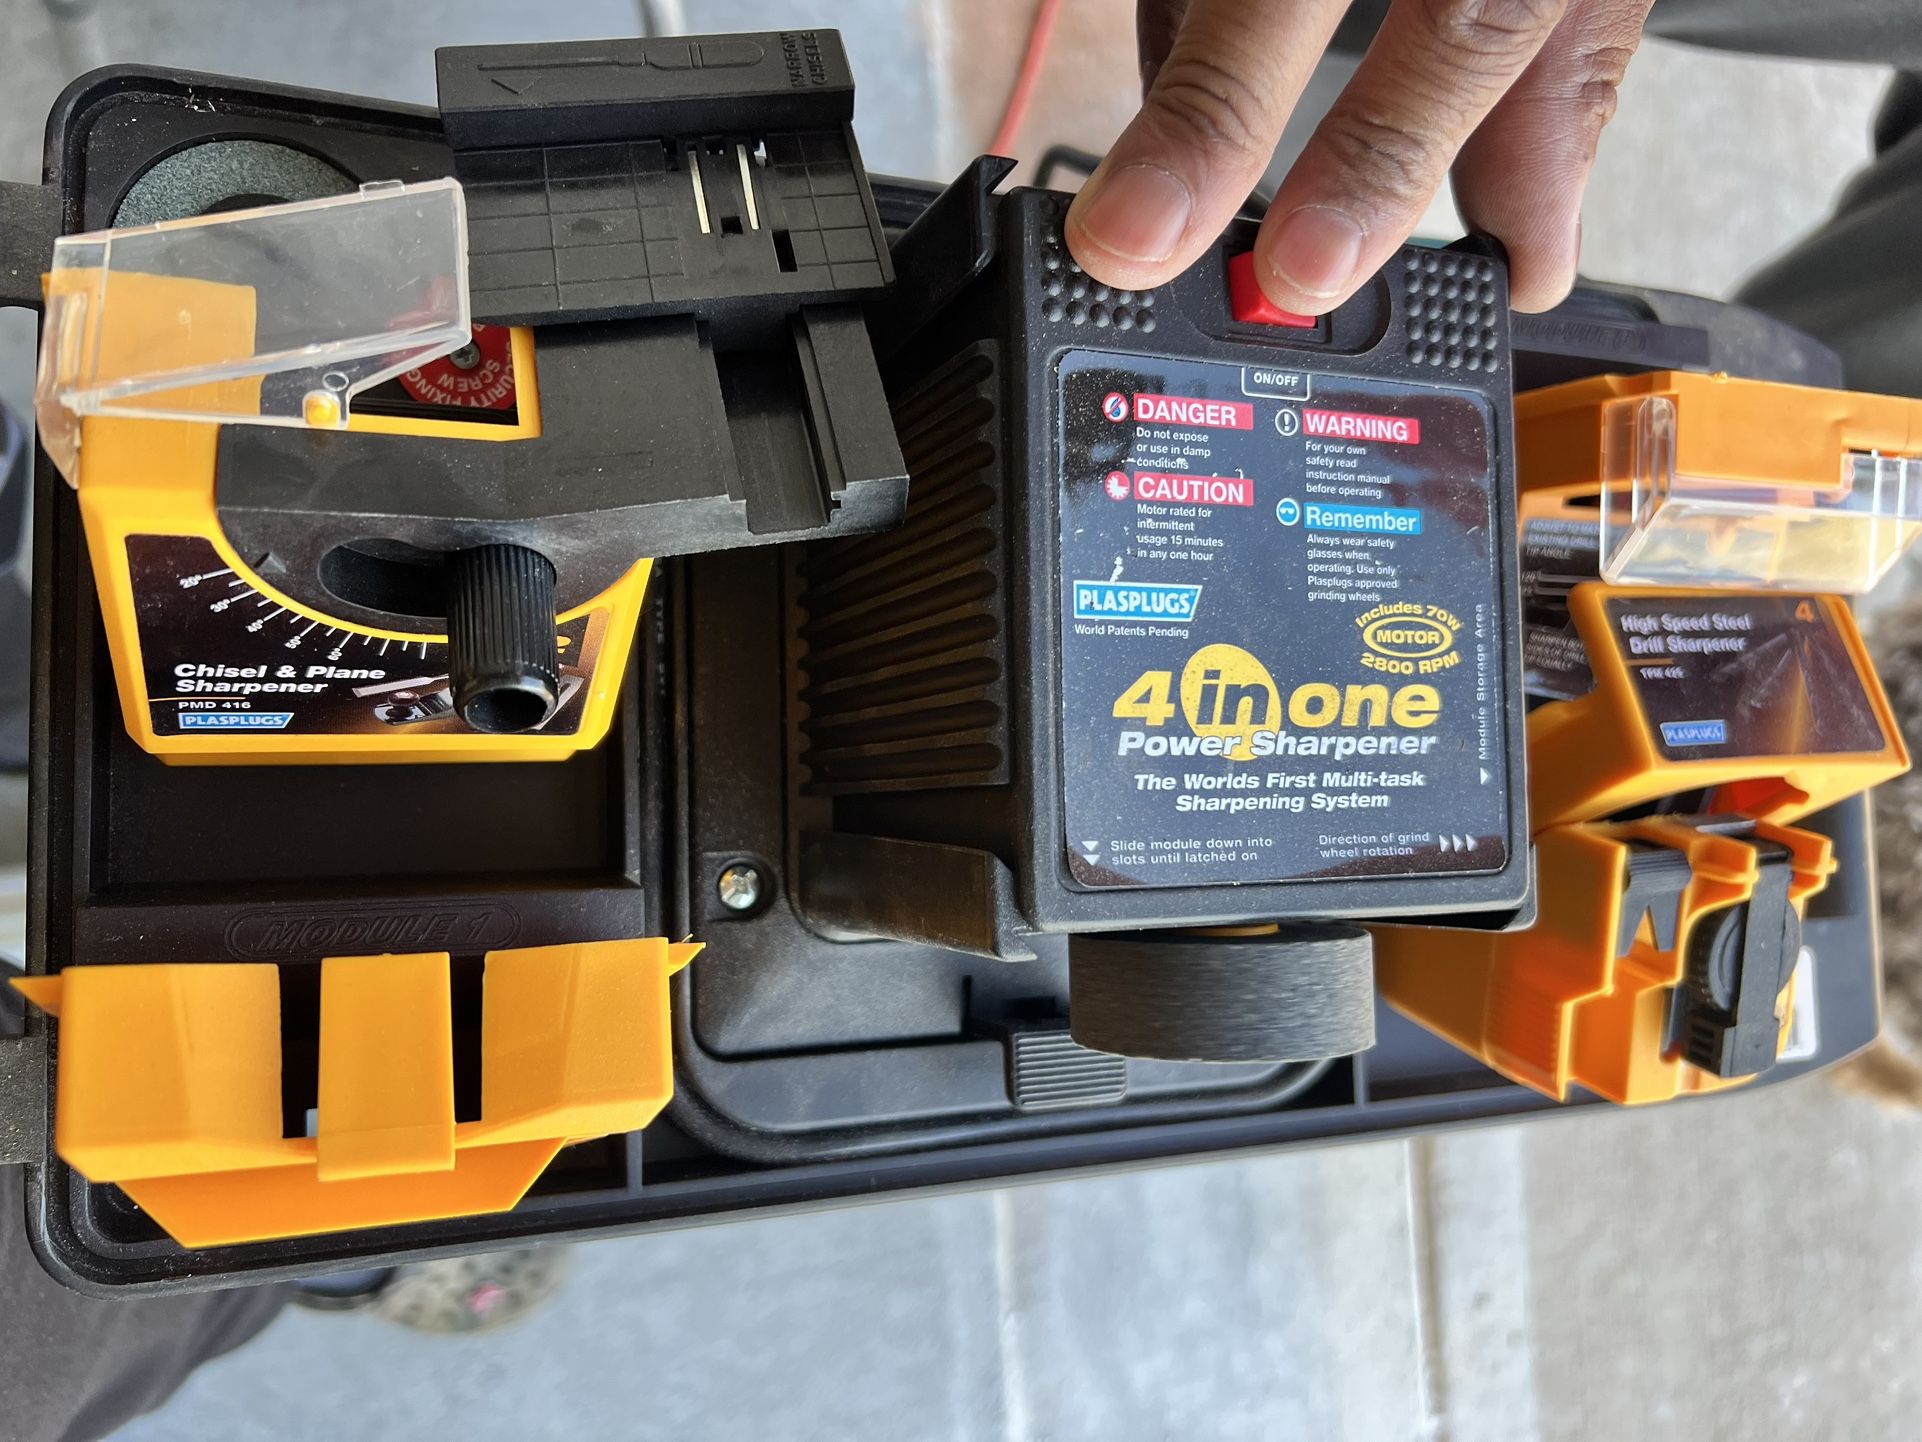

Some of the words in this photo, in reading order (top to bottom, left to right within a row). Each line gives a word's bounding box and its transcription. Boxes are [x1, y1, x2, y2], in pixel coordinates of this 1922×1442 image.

[437, 359, 501, 393] SCREW
[1253, 372, 1299, 387] ON/OFF
[1137, 398, 1237, 427] DANGER
[1305, 412, 1409, 441] WARNING
[1136, 426, 1151, 438] Do
[1153, 429, 1171, 440] not
[1173, 432, 1209, 443] expose
[1136, 443, 1148, 452] or
[1150, 444, 1169, 454] use
[1171, 443, 1181, 455] in
[1182, 445, 1211, 458] damp
[1305, 441, 1321, 451] For
[1324, 444, 1345, 454] your
[1346, 446, 1366, 456] own
[1136, 457, 1190, 470] conditions
[1305, 456, 1334, 468] safety
[1336, 459, 1357, 468] read
[1305, 470, 1355, 482] instruction
[1357, 474, 1391, 484] manual
[1138, 477, 1244, 504] CAUTION
[1306, 483, 1336, 494] before
[1338, 486, 1382, 499] operating
[1137, 503, 1167, 515] Motor
[1169, 507, 1196, 517] rated
[1198, 508, 1213, 518] for
[1137, 519, 1195, 531] intermittent
[1306, 506, 1417, 532] Remember
[1137, 535, 1168, 547] usage
[1171, 534, 1183, 545] 15
[1184, 536, 1224, 547] minutes
[1307, 533, 1340, 547] Always
[1342, 536, 1364, 546] wear
[1367, 537, 1395, 550] safety
[1527, 533, 1568, 546] EXISTING
[1569, 535, 1596, 548] DRILL
[1137, 548, 1147, 558] in
[1149, 550, 1168, 561] any
[1169, 551, 1189, 560] one
[1190, 551, 1214, 561] hour
[1307, 548, 1342, 560] glasses
[1344, 551, 1370, 560] when
[1526, 545, 1540, 557] TIP
[1540, 546, 1572, 559] ANGLE
[1307, 563, 1354, 575] operating.
[1356, 564, 1375, 574] Use
[1376, 566, 1396, 577] only
[179, 574, 203, 589] 20°
[1307, 575, 1353, 589] Plasplugs
[1355, 579, 1398, 590] approved
[1079, 589, 1191, 615] PLASPLUGS
[1307, 590, 1346, 603] grinding
[1348, 591, 1381, 602] wheels
[210, 598, 230, 613] 30°
[1795, 600, 1814, 623] 4
[1355, 601, 1423, 628] Includes
[1426, 605, 1462, 631] 70W
[1475, 603, 1484, 638] Area
[1620, 613, 1658, 635] High
[1661, 612, 1710, 634] Speed
[1712, 612, 1751, 631] Steel
[245, 618, 264, 633] 40°
[1074, 623, 1105, 635] World
[1107, 624, 1146, 636] Patents
[1148, 626, 1189, 640] Pending
[283, 635, 301, 649] 50°
[1376, 630, 1441, 644] MOTOR
[1529, 631, 1568, 648] SHARPEN
[1629, 636, 1665, 654] Drill
[1666, 634, 1747, 655] Sharpener
[326, 647, 342, 661] 60°
[1360, 652, 1414, 675] 2800
[1418, 650, 1460, 674] RPM
[174, 663, 268, 678] Chisel
[275, 665, 297, 678] &
[306, 666, 386, 679] Plane
[1476, 643, 1487, 701] Storage
[175, 679, 328, 695] Sharpener
[178, 701, 217, 709] PMD
[221, 701, 251, 709] 416
[1112, 670, 1176, 726] 4
[1196, 669, 1271, 726] in
[1289, 682, 1441, 728] one
[184, 714, 283, 726] PLASPLUGS
[1478, 707, 1487, 761] Module
[1666, 725, 1722, 740] PLASPLUGS
[1117, 731, 1242, 757] Power
[1250, 730, 1437, 760] Sharpener
[1134, 773, 1177, 790] The
[1183, 773, 1260, 789] Worlds
[1266, 772, 1316, 788] First
[1322, 771, 1426, 788] Multi-task
[1175, 794, 1305, 814] Sharpening
[1311, 792, 1389, 812] System
[1110, 840, 1145, 851] Slide
[1150, 838, 1201, 850] module
[1206, 837, 1243, 849] down
[1247, 837, 1273, 848] into
[1319, 833, 1376, 846] Direction
[1381, 832, 1393, 843] of
[1397, 832, 1430, 845] grind
[1112, 853, 1146, 865] slots
[1150, 852, 1181, 864] until
[1185, 851, 1236, 863] latched
[1241, 852, 1258, 861] on
[1319, 846, 1359, 859] wheel
[1363, 845, 1413, 857] rotation
[256, 913, 458, 952] MODULE
[466, 911, 495, 943] 1
